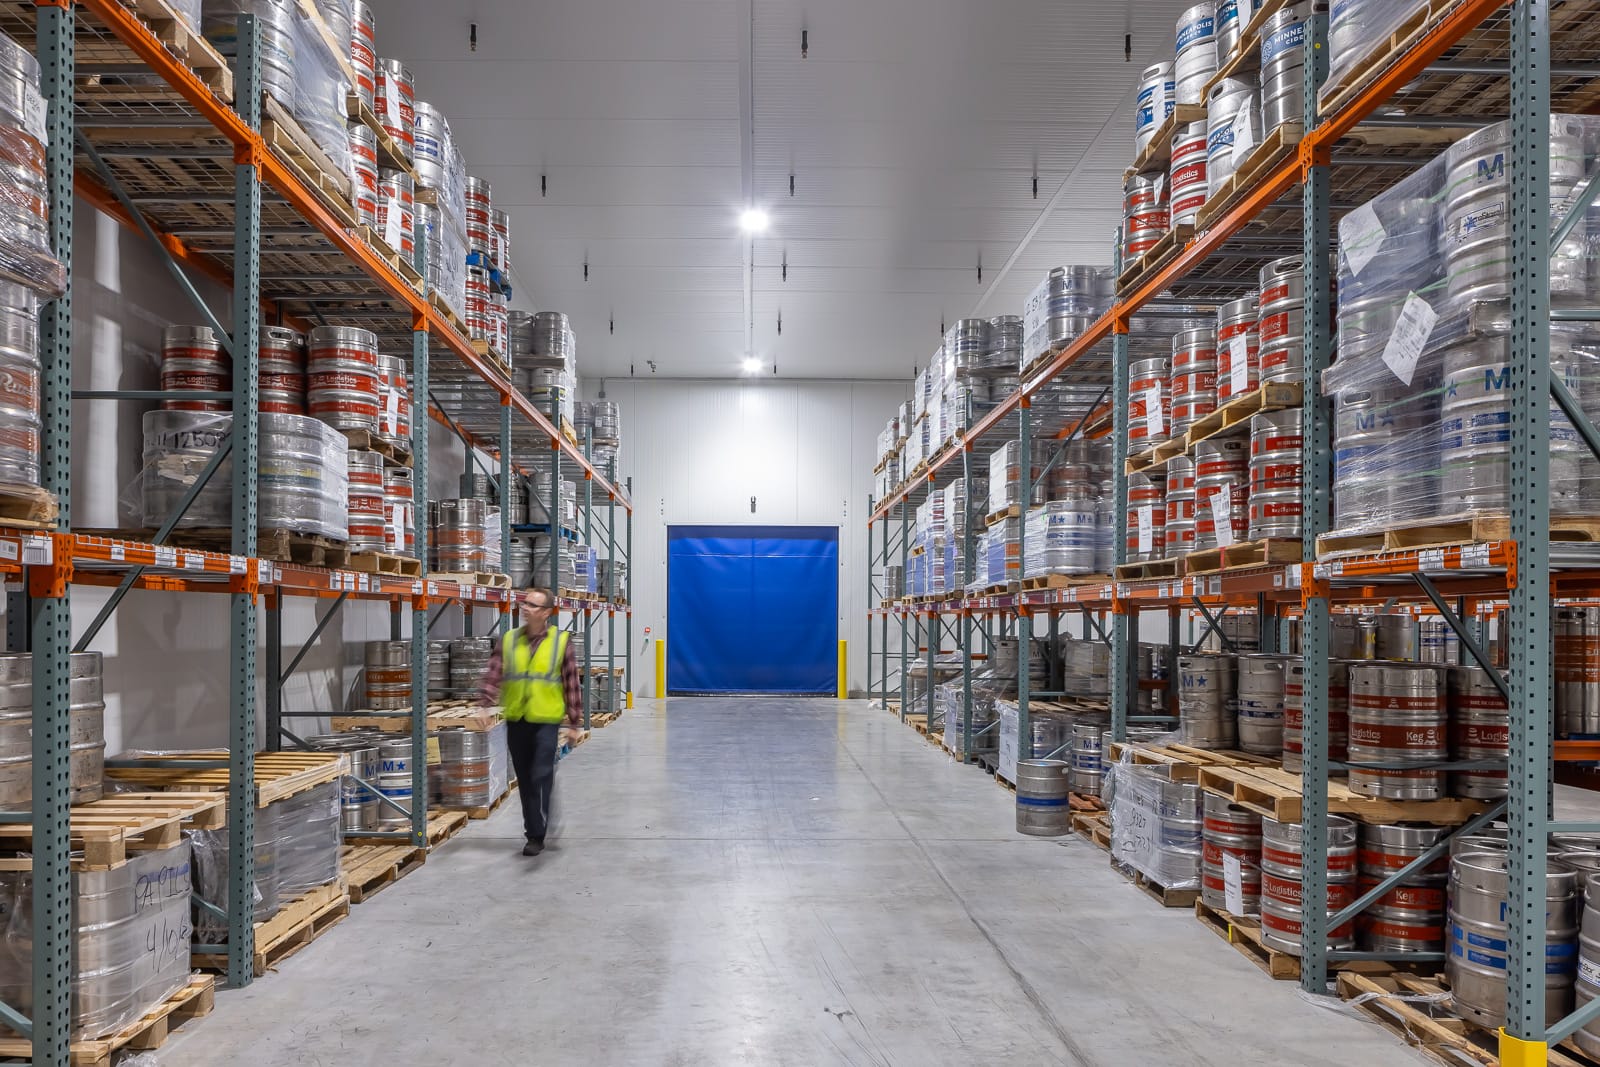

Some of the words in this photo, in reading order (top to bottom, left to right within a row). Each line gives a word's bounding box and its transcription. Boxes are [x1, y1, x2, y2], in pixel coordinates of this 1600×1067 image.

[1285, 34, 1304, 45] CIDE
[1182, 675, 1194, 687] M
[1352, 728, 1381, 740] Logistics
[1406, 731, 1424, 743] Keg
[1481, 730, 1508, 742] Logis
[1083, 740, 1092, 749] M
[383, 761, 394, 771] M
[1269, 882, 1302, 898] Logistics
